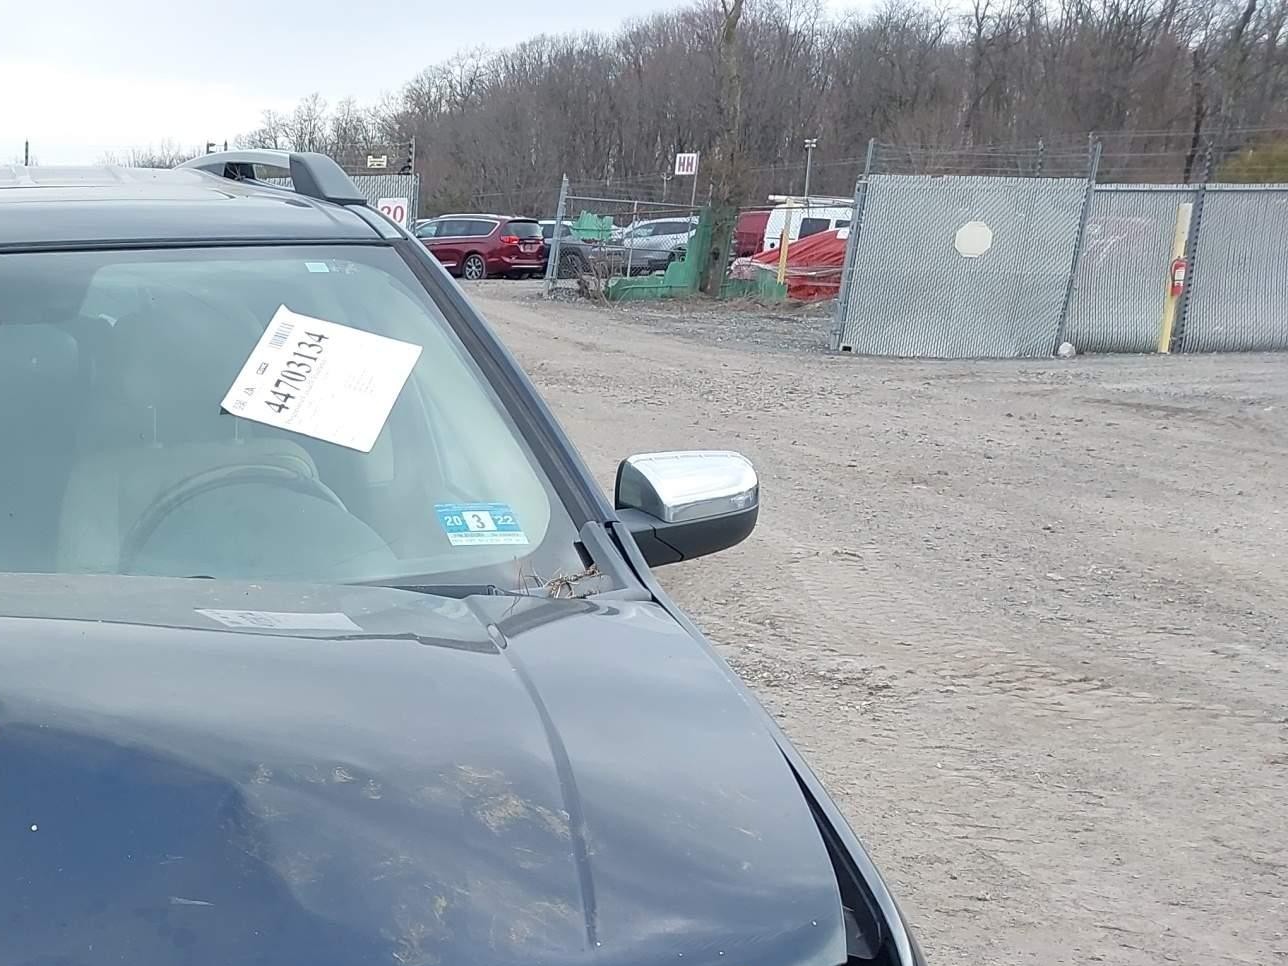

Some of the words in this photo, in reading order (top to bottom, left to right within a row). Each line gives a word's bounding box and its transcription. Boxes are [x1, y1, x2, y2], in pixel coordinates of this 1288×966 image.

[678, 156, 695, 172] HH
[264, 331, 329, 414] 44703134
[444, 515, 463, 526] 20
[471, 513, 486, 529] 3
